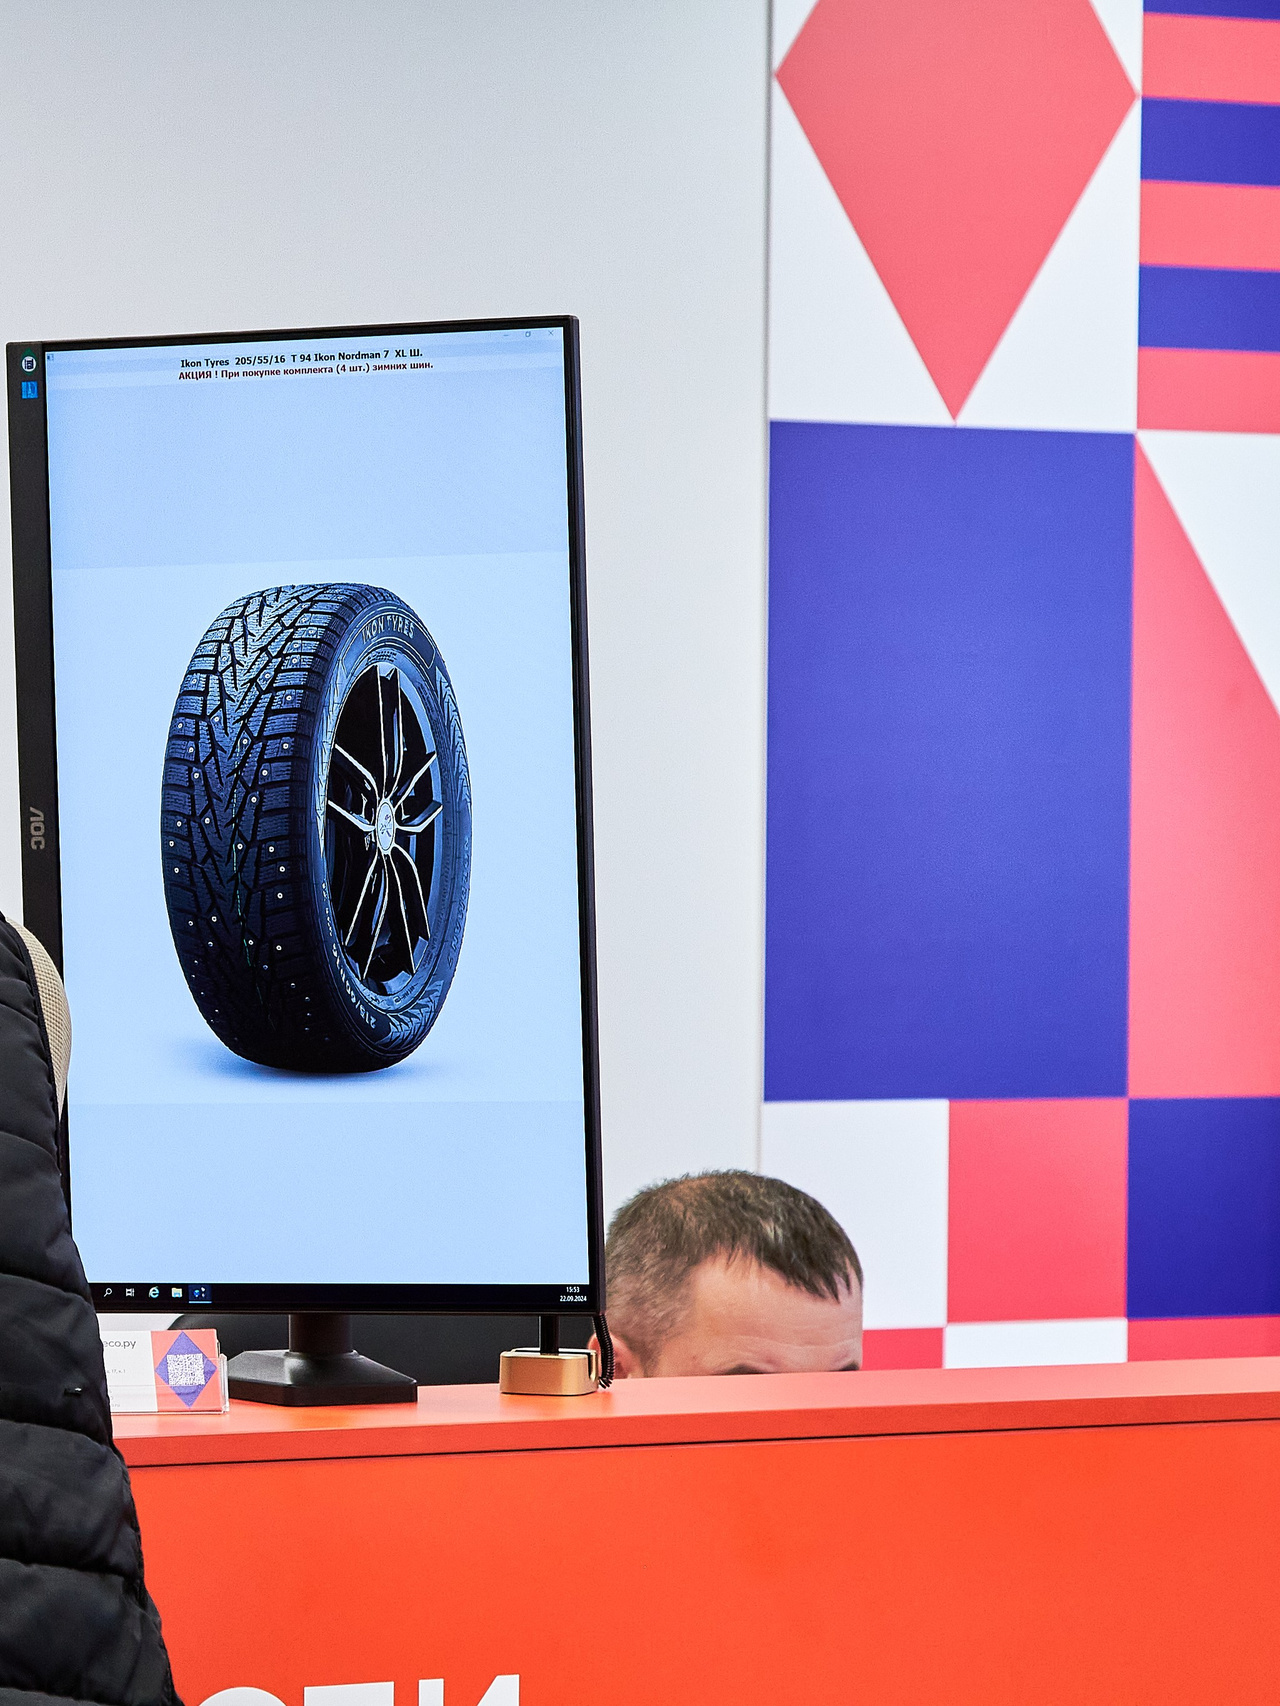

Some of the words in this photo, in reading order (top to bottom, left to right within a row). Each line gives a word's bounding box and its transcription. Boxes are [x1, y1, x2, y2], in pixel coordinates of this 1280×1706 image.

[178, 370, 212, 381] АКЦИЯ
[221, 370, 240, 380] При
[242, 368, 281, 378] покупке
[283, 367, 333, 376] комплекта
[336, 364, 346, 374] (4
[349, 362, 370, 374] шт.)
[372, 363, 407, 372] зимних
[409, 362, 434, 370] шин.
[180, 359, 202, 368] Ikon
[204, 358, 230, 369] Tyres
[235, 355, 286, 366] 205/55/16
[291, 354, 297, 363] T
[300, 353, 311, 362] 94
[314, 352, 336, 362] Ikon
[338, 351, 381, 361] Nordman
[383, 350, 390, 359] 7
[394, 349, 407, 358] XL
[362, 615, 385, 645] IKON
[387, 614, 415, 640] TYRES
[29, 806, 45, 850] AOC
